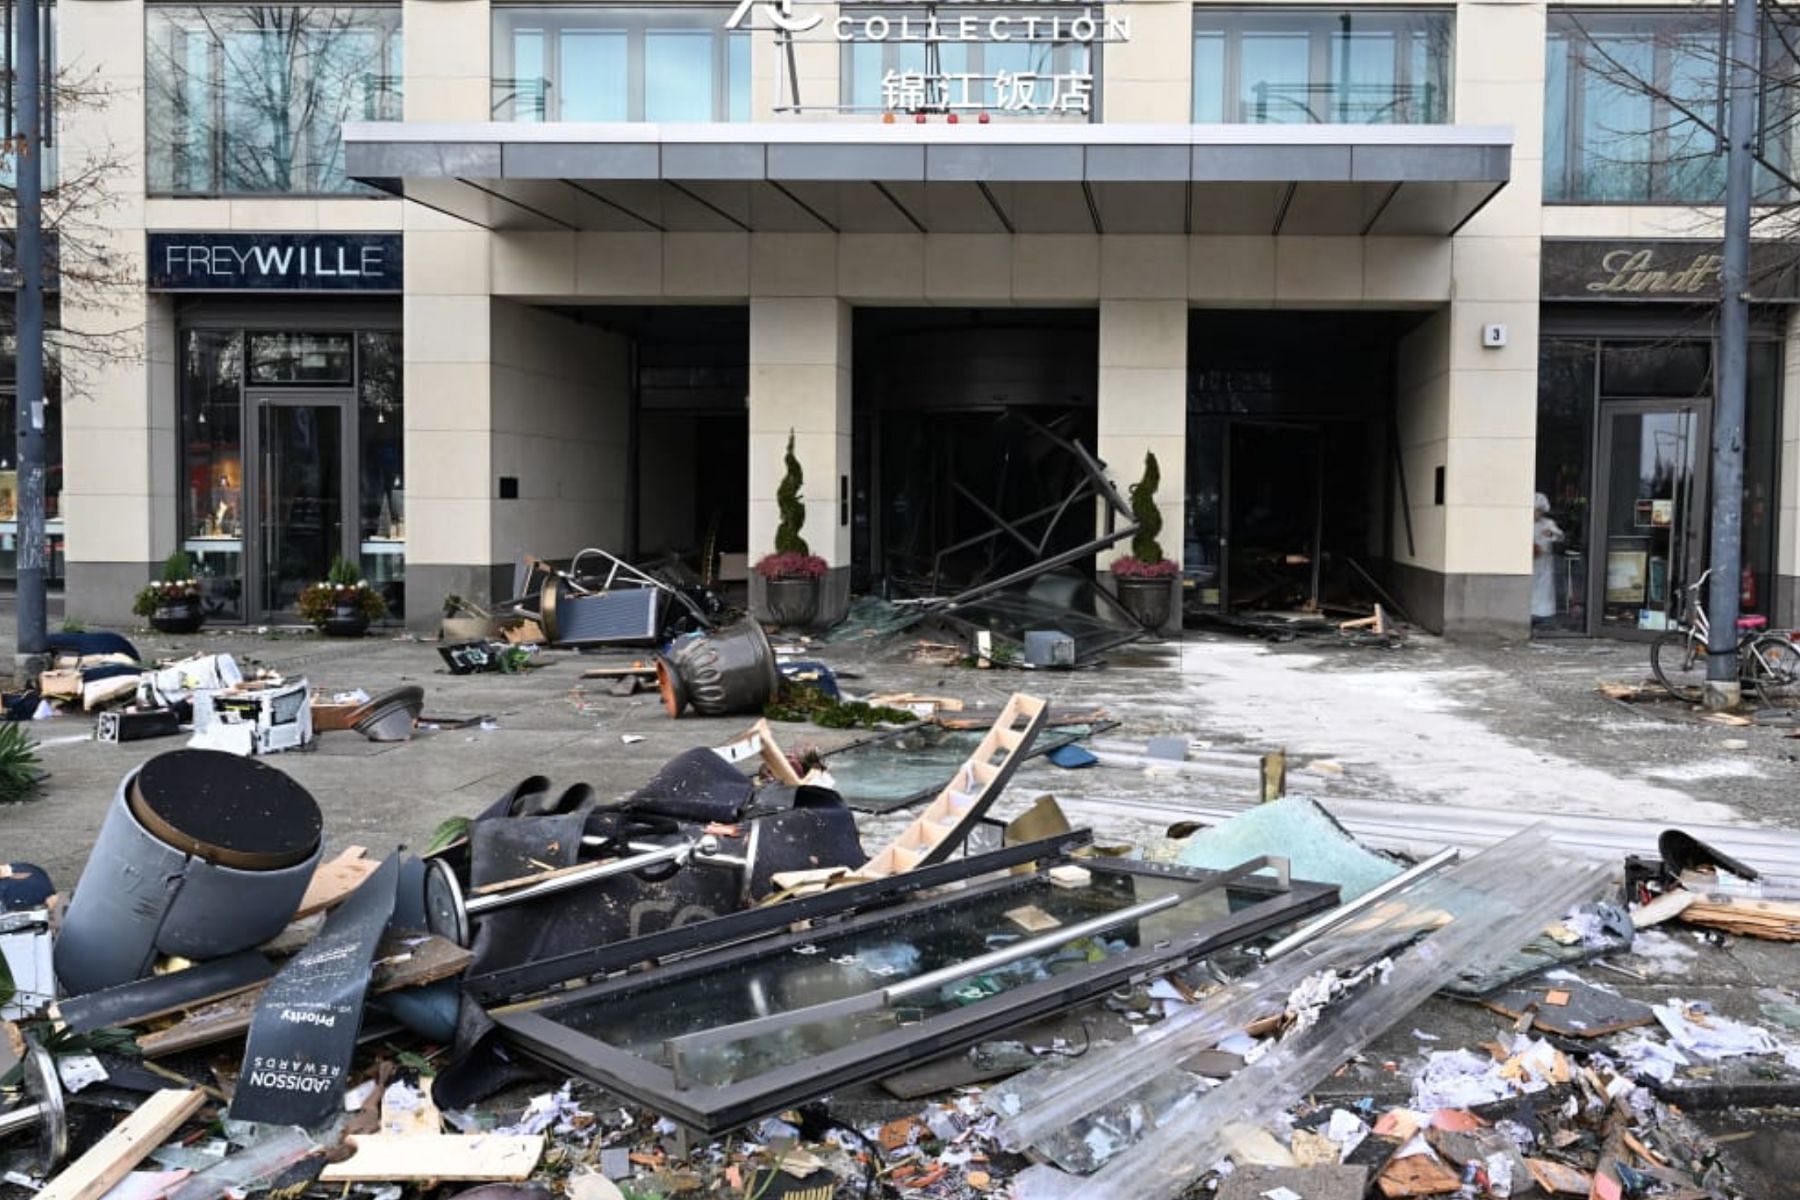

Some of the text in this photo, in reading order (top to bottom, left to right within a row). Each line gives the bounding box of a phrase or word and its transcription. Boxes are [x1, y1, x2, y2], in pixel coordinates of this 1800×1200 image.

[833, 15, 1131, 41] COLLECTION
[882, 69, 1093, 112] 锦江饭店
[166, 246, 385, 276] FREYWILLE
[1586, 250, 1725, 292] Lindt
[1492, 327, 1500, 341] 3
[280, 1009, 335, 1028] Priority
[254, 1057, 340, 1076] REWARDS
